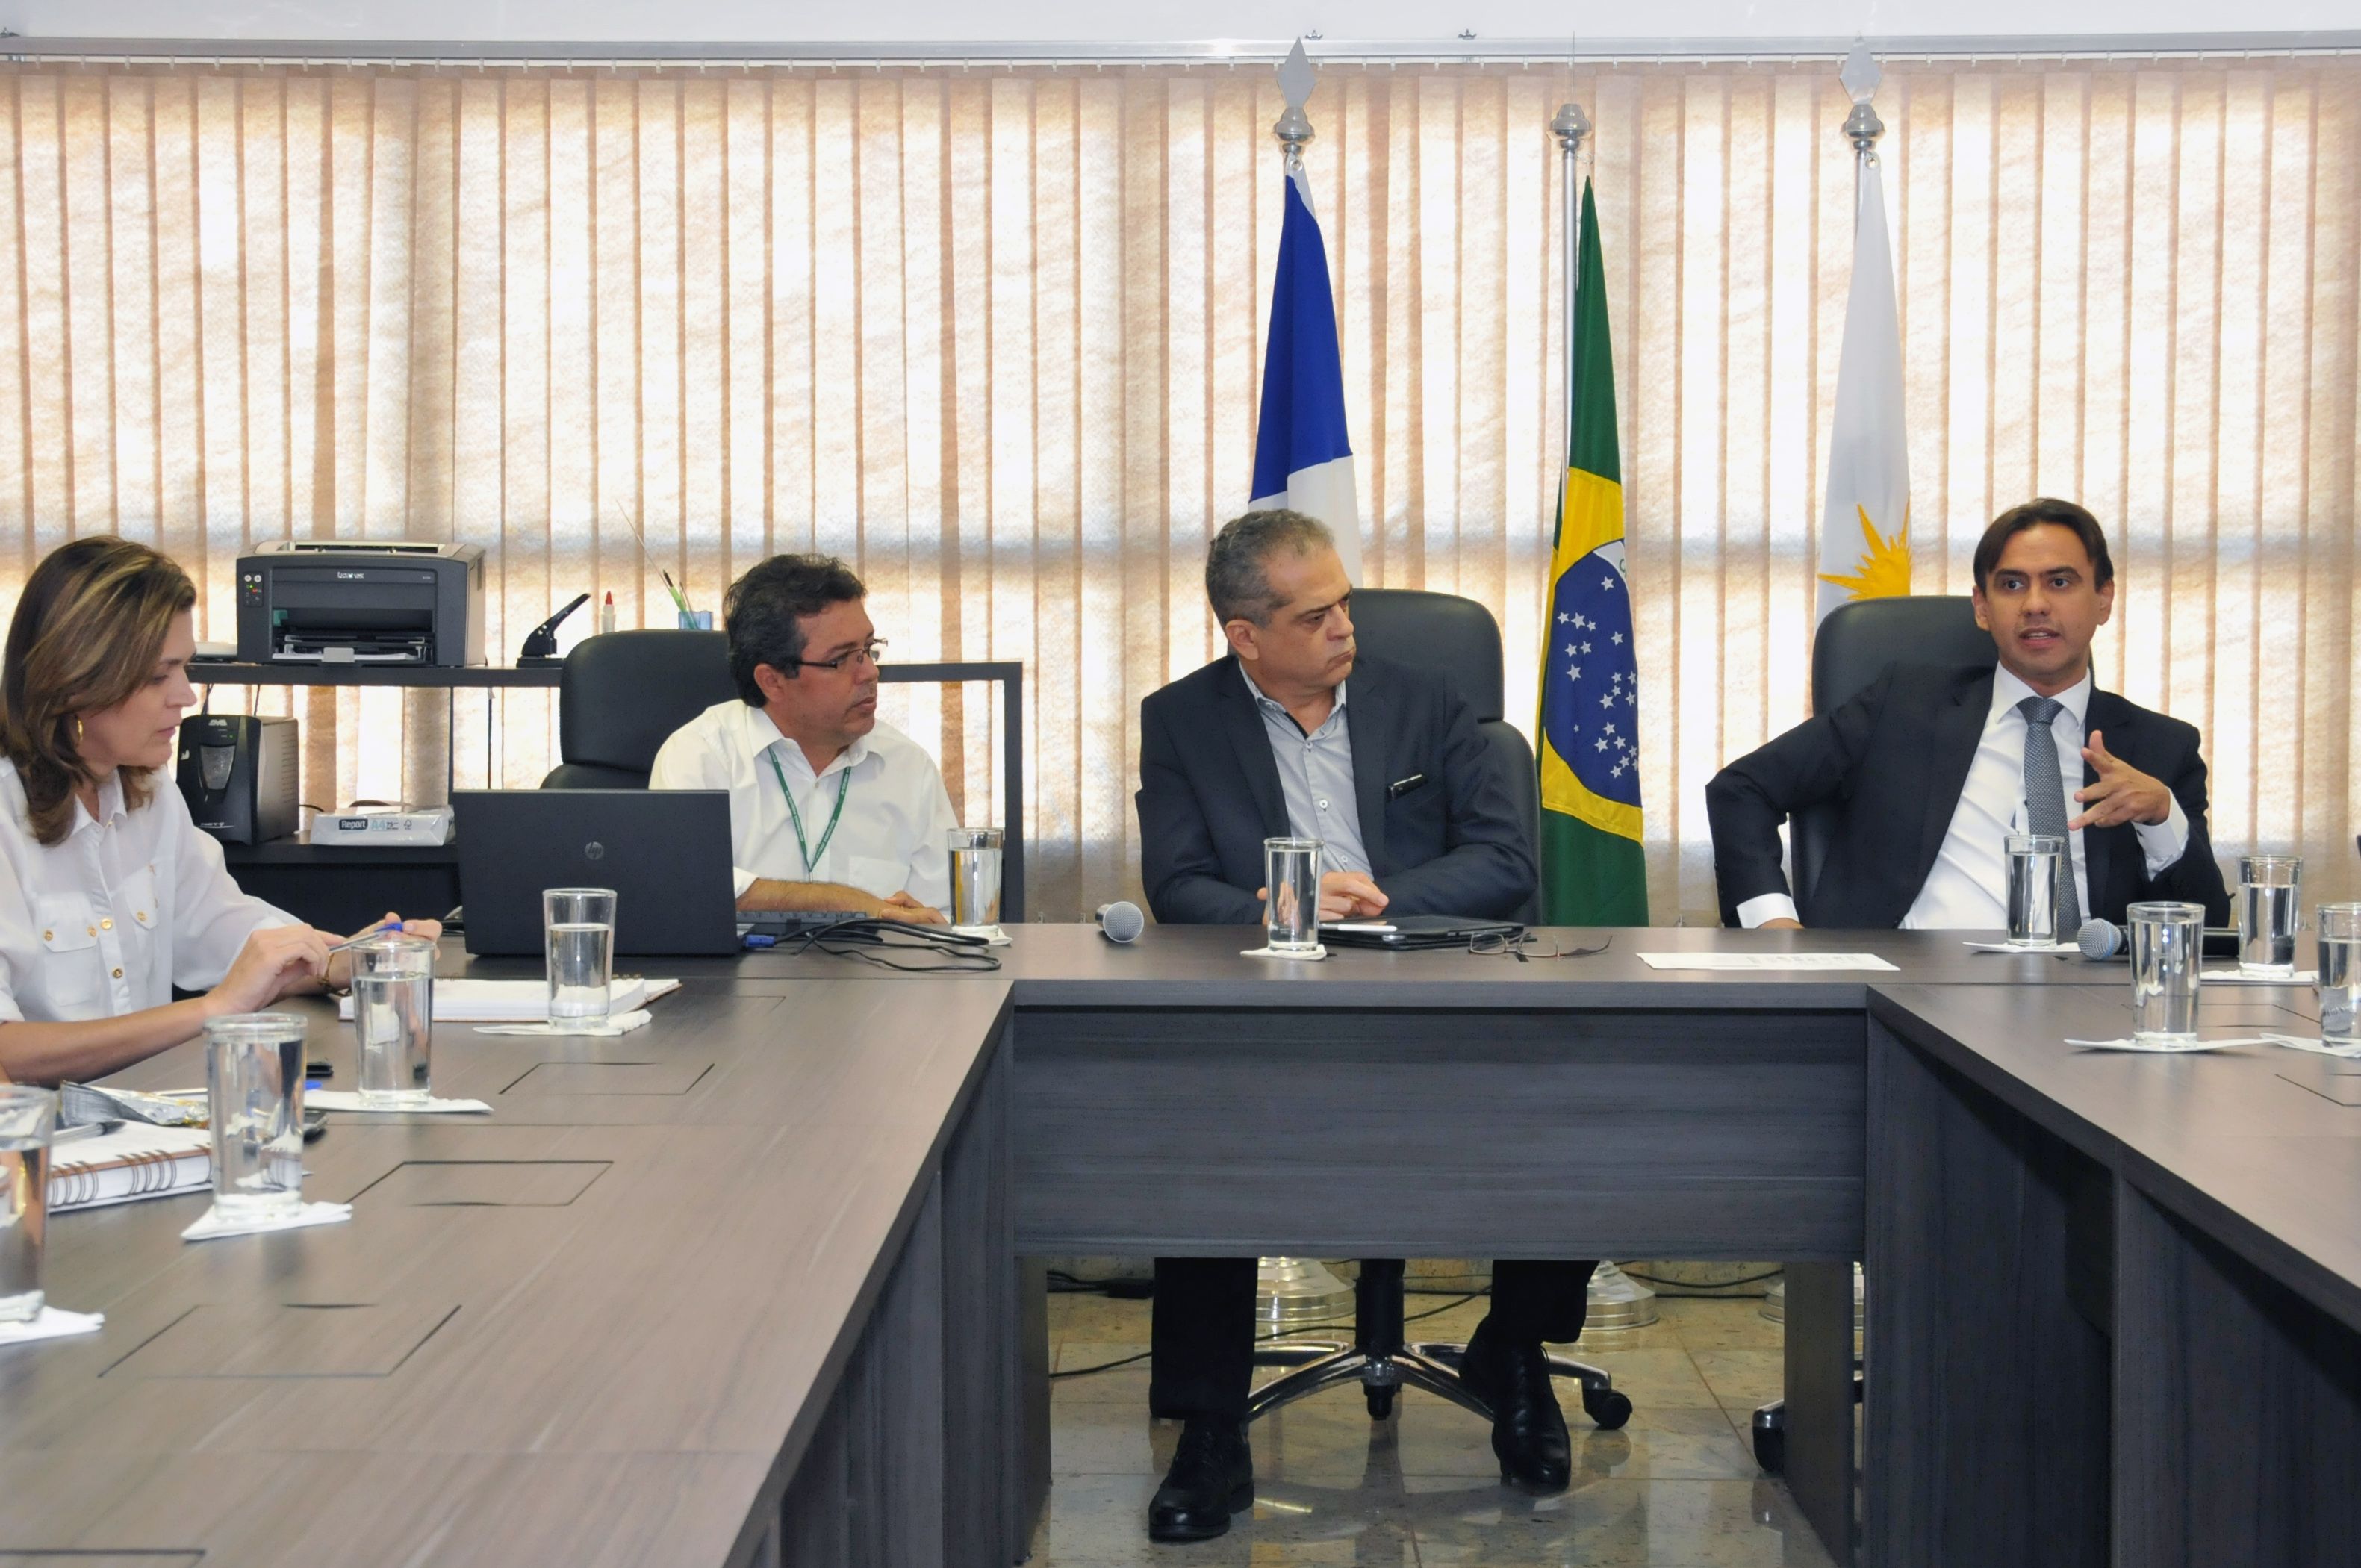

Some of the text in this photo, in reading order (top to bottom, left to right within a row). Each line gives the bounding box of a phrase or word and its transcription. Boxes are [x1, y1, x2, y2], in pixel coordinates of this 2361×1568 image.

[341, 820, 365, 830] Report
[372, 819, 386, 830] A4
[585, 841, 603, 859] hp
